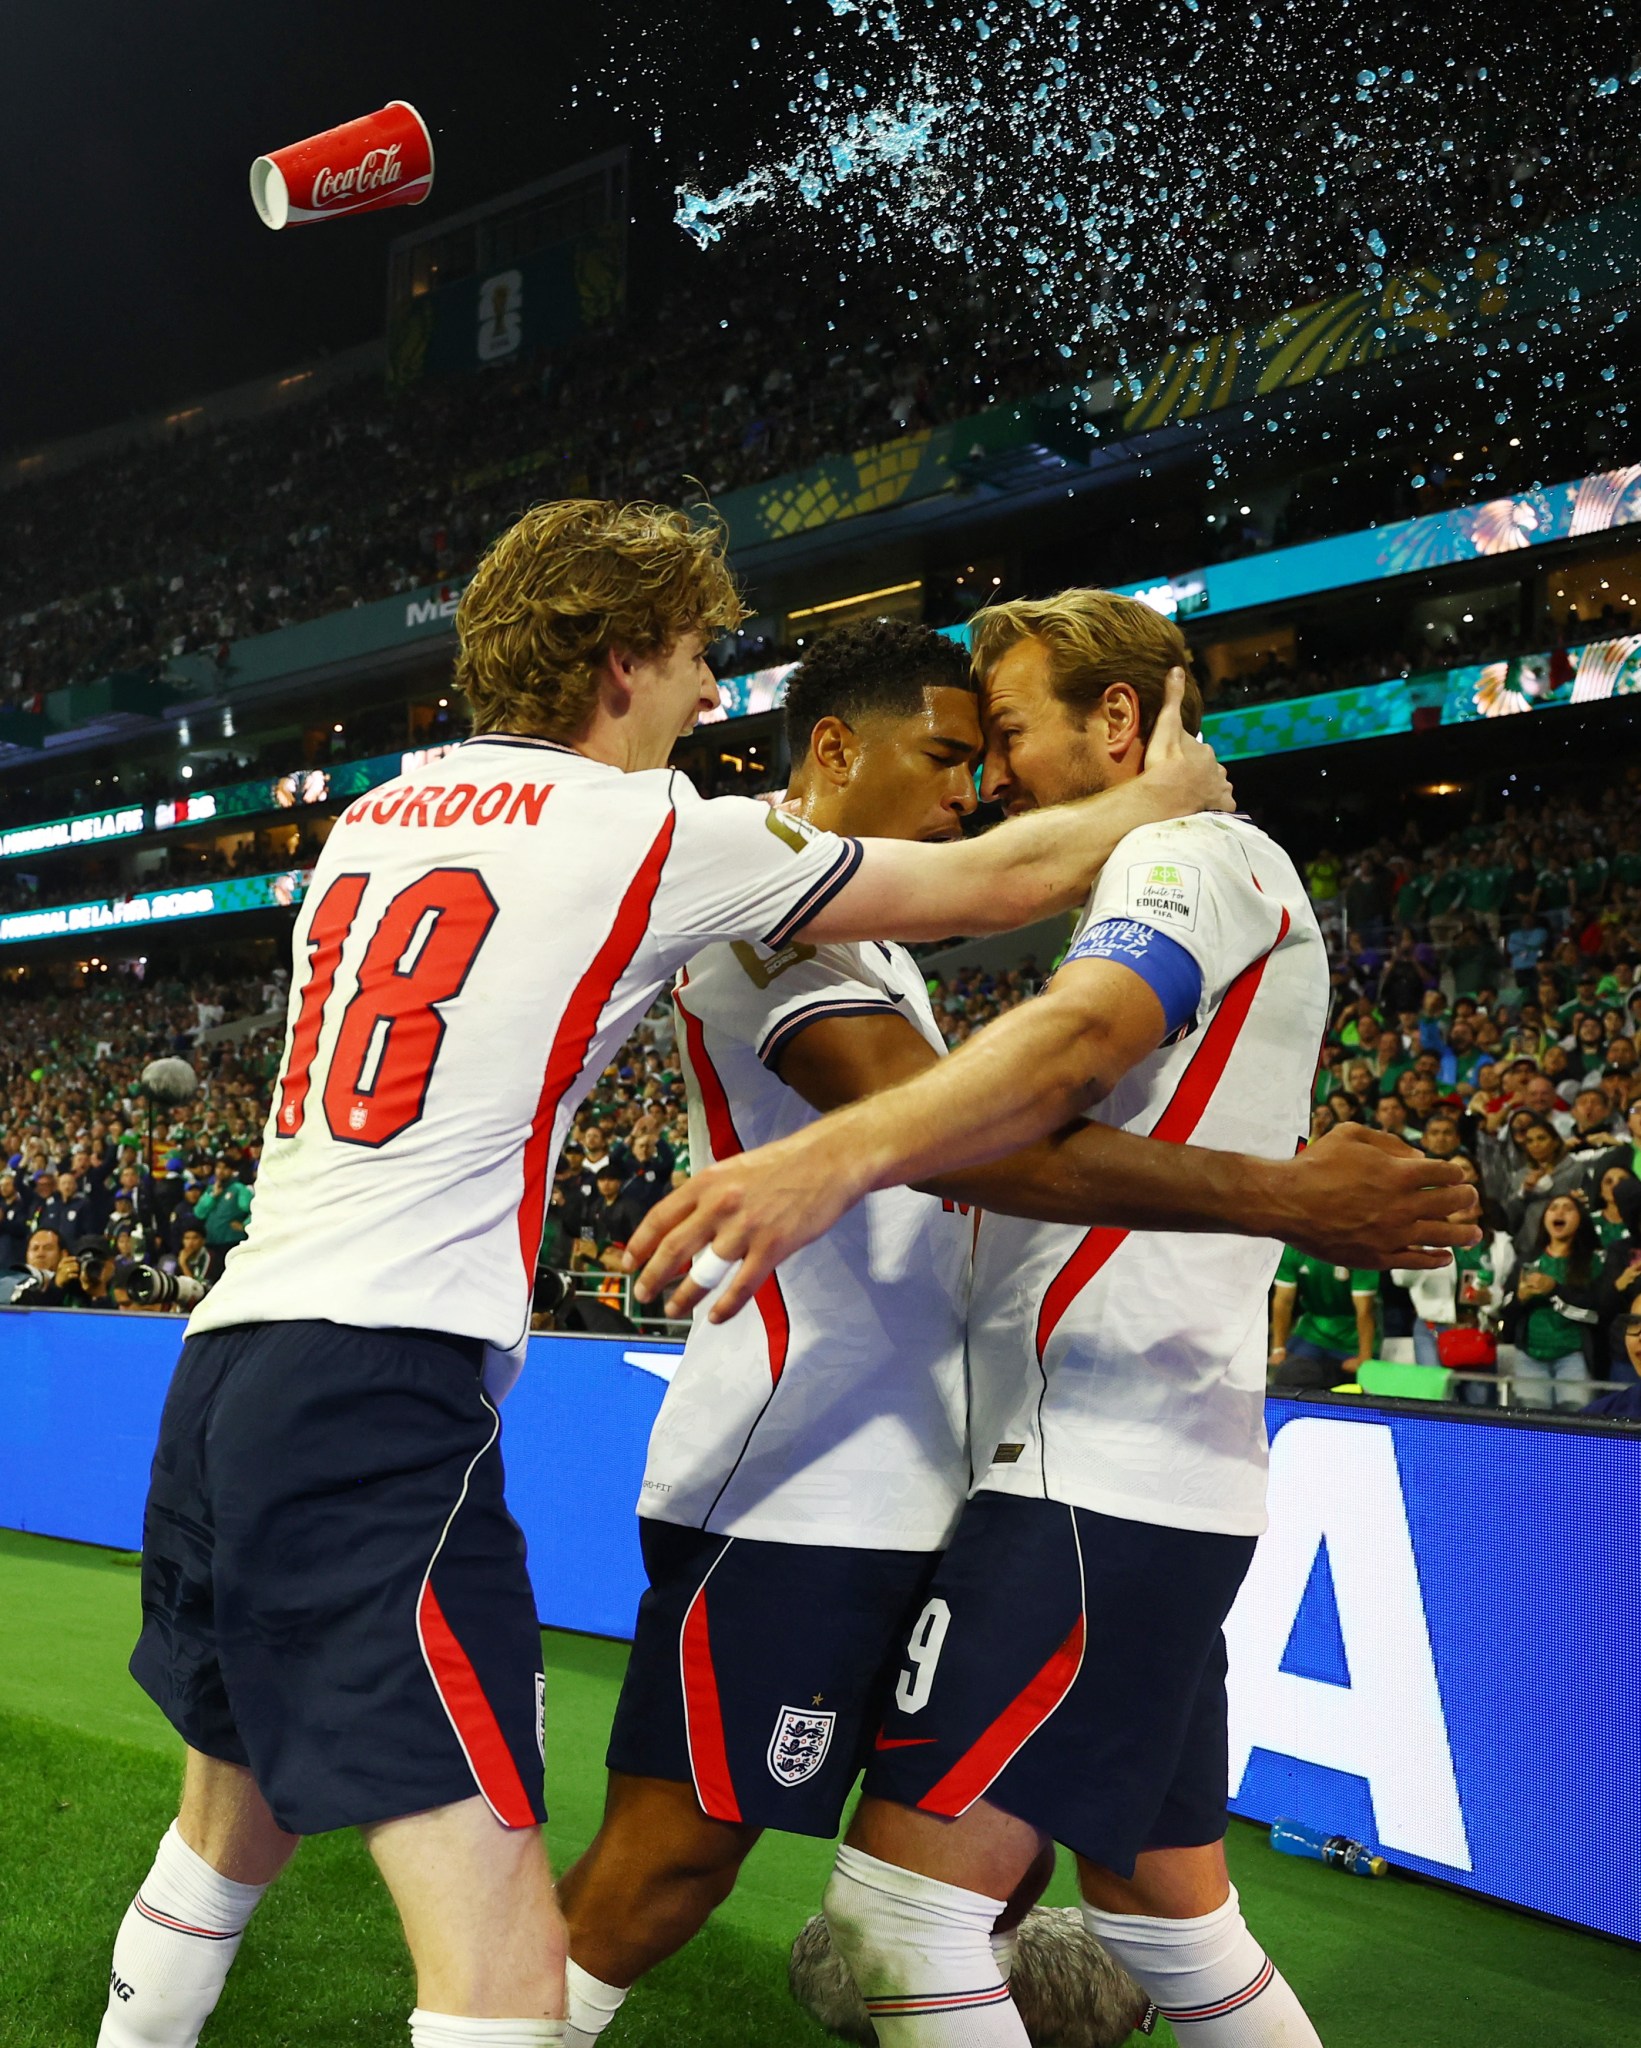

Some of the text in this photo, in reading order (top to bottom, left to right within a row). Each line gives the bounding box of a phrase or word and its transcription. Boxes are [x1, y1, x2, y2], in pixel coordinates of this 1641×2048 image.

[311, 142, 402, 208] Coca-Cola
[345, 781, 556, 828] GORDON
[151, 889, 214, 918] 2026
[1136, 898, 1190, 917] EDUCATION
[1153, 909, 1173, 919] FIFA
[275, 867, 500, 1148] 18
[895, 1597, 952, 1715] 9
[110, 1970, 136, 2003] NG
